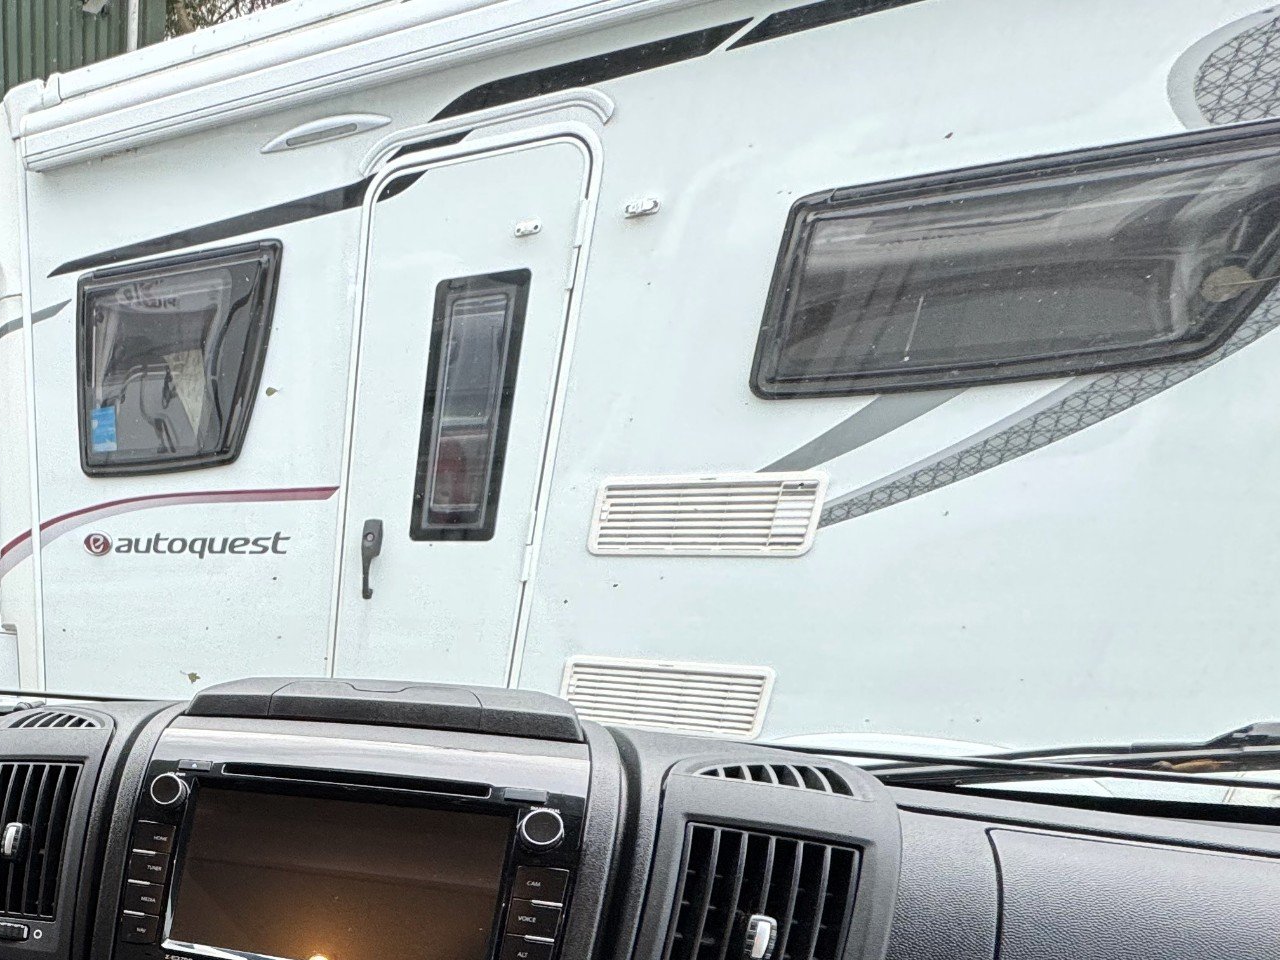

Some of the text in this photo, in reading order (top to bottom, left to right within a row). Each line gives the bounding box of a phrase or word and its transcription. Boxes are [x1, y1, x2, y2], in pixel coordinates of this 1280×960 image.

[114, 531, 291, 559] autoquest
[526, 880, 541, 888] CAM
[518, 915, 537, 923] VOICE
